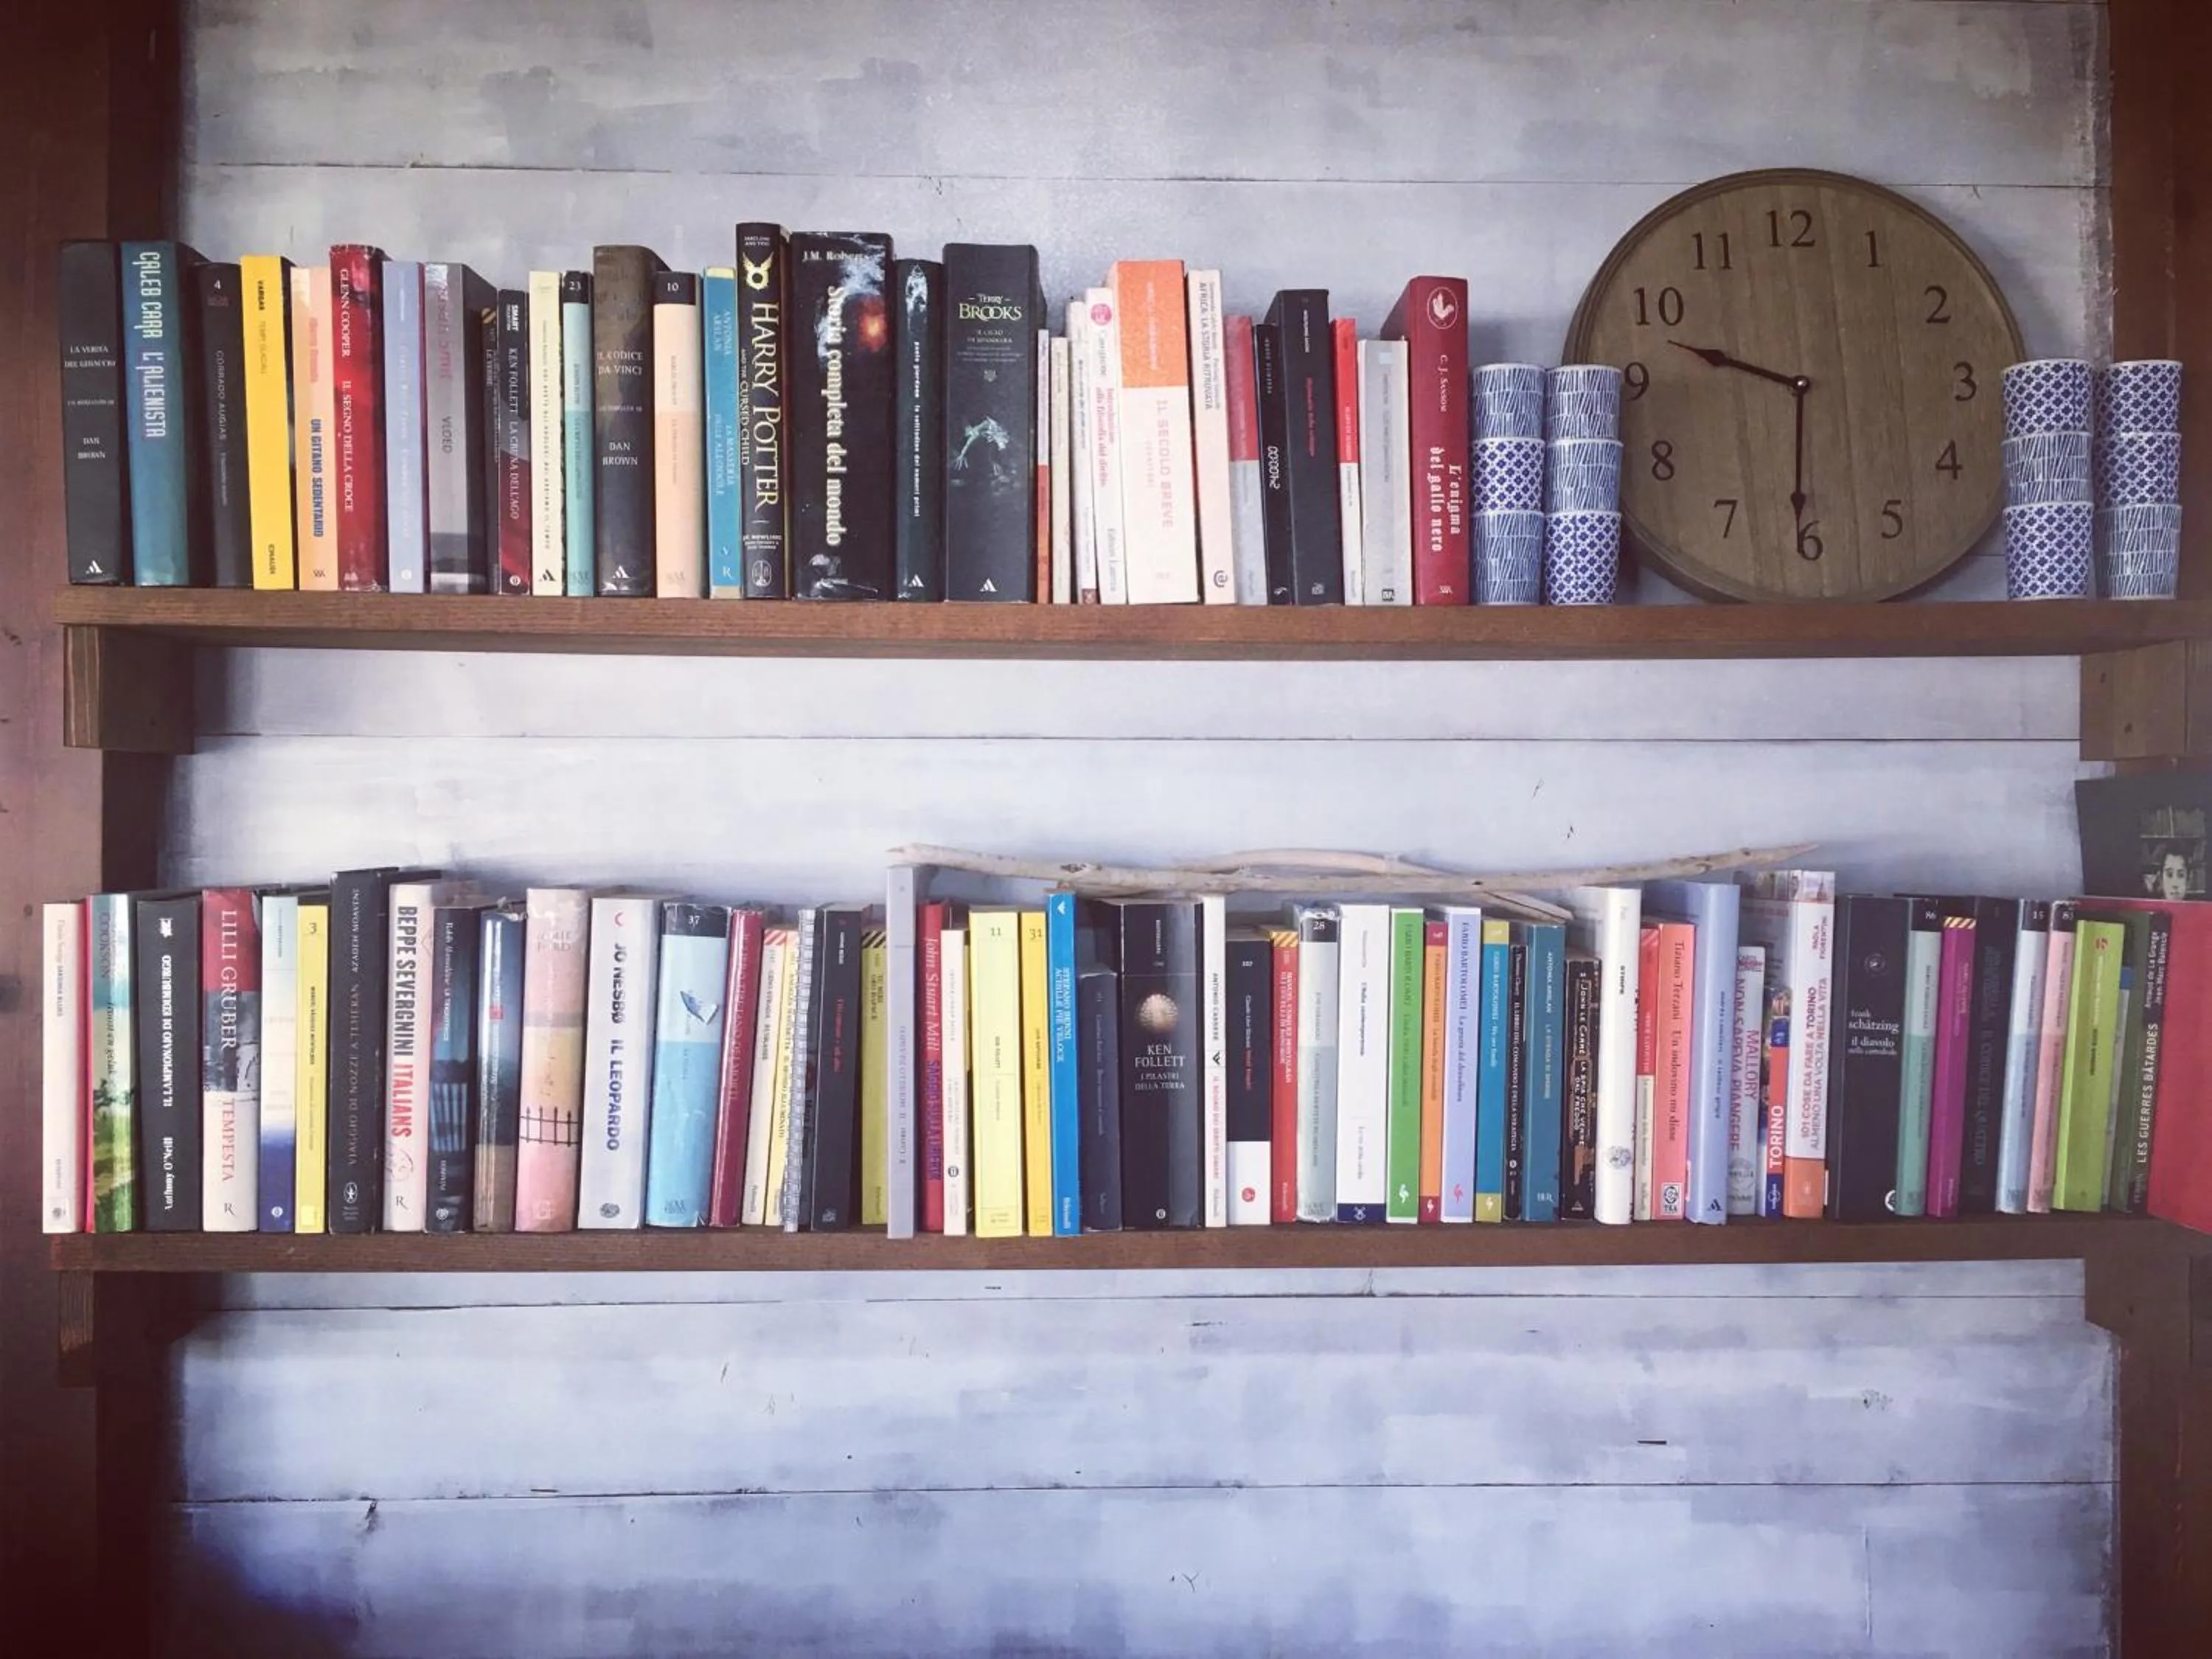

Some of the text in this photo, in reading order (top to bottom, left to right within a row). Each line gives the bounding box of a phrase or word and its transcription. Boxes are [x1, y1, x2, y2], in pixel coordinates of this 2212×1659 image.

[1766, 209, 1816, 248] 12
[1692, 232, 1733, 270] 11
[1865, 230, 1882, 268] 1
[214, 280, 220, 289] 4
[257, 280, 265, 311] VARGAS
[667, 282, 679, 292] 10
[976, 293, 1004, 304] TERRY
[1924, 285, 1951, 324] 2
[511, 305, 519, 332] SMART
[959, 303, 1023, 321] BROOKS
[1632, 286, 1685, 326] 10
[133, 251, 166, 438] CALEB CARR L'ALIENISTA
[713, 313, 723, 351] ARSLAN
[723, 311, 732, 355] ANTONIA
[751, 301, 779, 398] HARRY
[216, 350, 225, 399] CORRADO
[508, 348, 518, 370] KEN
[598, 365, 642, 375] DA VINCI
[606, 351, 644, 361] CODICE
[1200, 318, 1212, 410] LA STORIA RITROVATA
[1438, 366, 1448, 375] J.
[1440, 354, 1448, 364] C.
[340, 268, 353, 513] GLENN COOPER IL SEGNO DELLA CROCE
[509, 371, 518, 414] FOLLETT
[1624, 362, 1649, 401] 9
[1954, 361, 1977, 401] 3
[218, 403, 227, 441] AUGIAS
[740, 380, 750, 426] CURSED
[821, 286, 846, 546] Storia completa del mondo
[83, 437, 100, 445] DAN
[442, 416, 453, 454] VLOED
[509, 421, 518, 435] LA
[1095, 406, 1105, 441] filosofia
[77, 451, 106, 459] BROWN
[602, 456, 638, 465] BROWN
[609, 442, 630, 451] DAN
[726, 438, 735, 486] MASSERIA
[741, 428, 750, 465] CHILD
[751, 405, 781, 513] POTTER
[1097, 444, 1107, 458] del
[1156, 400, 1173, 529] IL SECOLO BREVE
[1651, 440, 1674, 481] 8
[1935, 441, 1963, 480] 4
[311, 419, 323, 538] UN GITANO SEDENTARIO
[714, 442, 724, 496] ALLODOLE
[510, 472, 520, 521] DELL'AGO
[1427, 447, 1445, 552] del gallo nero
[1447, 464, 1463, 535] L'enigma
[1714, 499, 1737, 539] 7
[1881, 499, 1903, 539] 5
[1798, 519, 1823, 560] 6
[100, 911, 111, 978] COOKSON
[351, 935, 359, 973] AZADEH
[923, 936, 939, 968] John
[1402, 923, 1413, 1006] FABIO BARTOLOMEI
[1674, 940, 1685, 980] Tiziano
[1458, 922, 1470, 1010] FABIO BARTOLOMEI
[1490, 950, 1500, 1020] FABIO BARTOLOMEI
[2143, 931, 2158, 1009] Arnaud de La Grange
[349, 983, 360, 1037] TEHERAN
[925, 973, 939, 1016] Stuart
[1055, 967, 1065, 1062] ACHILLE VELOCE
[1062, 967, 1071, 1039] STEFANO BENNI
[1211, 972, 1220, 1040] ANTONIO CASSESE
[1579, 982, 1587, 1009] JOHN
[1672, 981, 1683, 1020] Terzani
[391, 905, 418, 1138] BEPPE SEVERGNINI ITALIANS
[926, 1022, 939, 1051] Mill
[1579, 1012, 1587, 1022] LE
[220, 909, 237, 1183] LILLI GRUBER TEMPESTA
[349, 1041, 359, 1050] A
[606, 942, 627, 1151] JO NESBØ IL LEOPARDO
[1147, 1043, 1172, 1055] KEN
[1578, 1024, 1588, 1055] CARRÉ
[1671, 1030, 1682, 1047] Un
[1851, 1035, 1895, 1047] il diavolo
[1135, 1055, 1186, 1068] FOLLETT
[1512, 1046, 1520, 1085] COMANDO
[1579, 1061, 1587, 1072] LA
[1669, 1049, 1681, 1097] indovino
[1729, 977, 1746, 1152] NON SAPEVA PIANGERE
[1745, 1029, 1759, 1101] MALLORY
[1801, 987, 1817, 1139] 101 COSE DA FARE A TORINO
[1811, 978, 1828, 1150] ALMENO UNA VOLTA NELLA VITA
[161, 955, 175, 1210] Anthony O'Neill IL LAMPIONAIO DI EDIMBURGO
[2138, 1023, 2158, 1164] LES GUERRES BÂTARDES
[348, 1097, 359, 1112] DI
[1573, 1095, 1581, 1130] FREDDO
[347, 1114, 358, 1166] VIAGGIO
[1668, 1115, 1679, 1141] disse
[1769, 1105, 1784, 1169] TORINO
